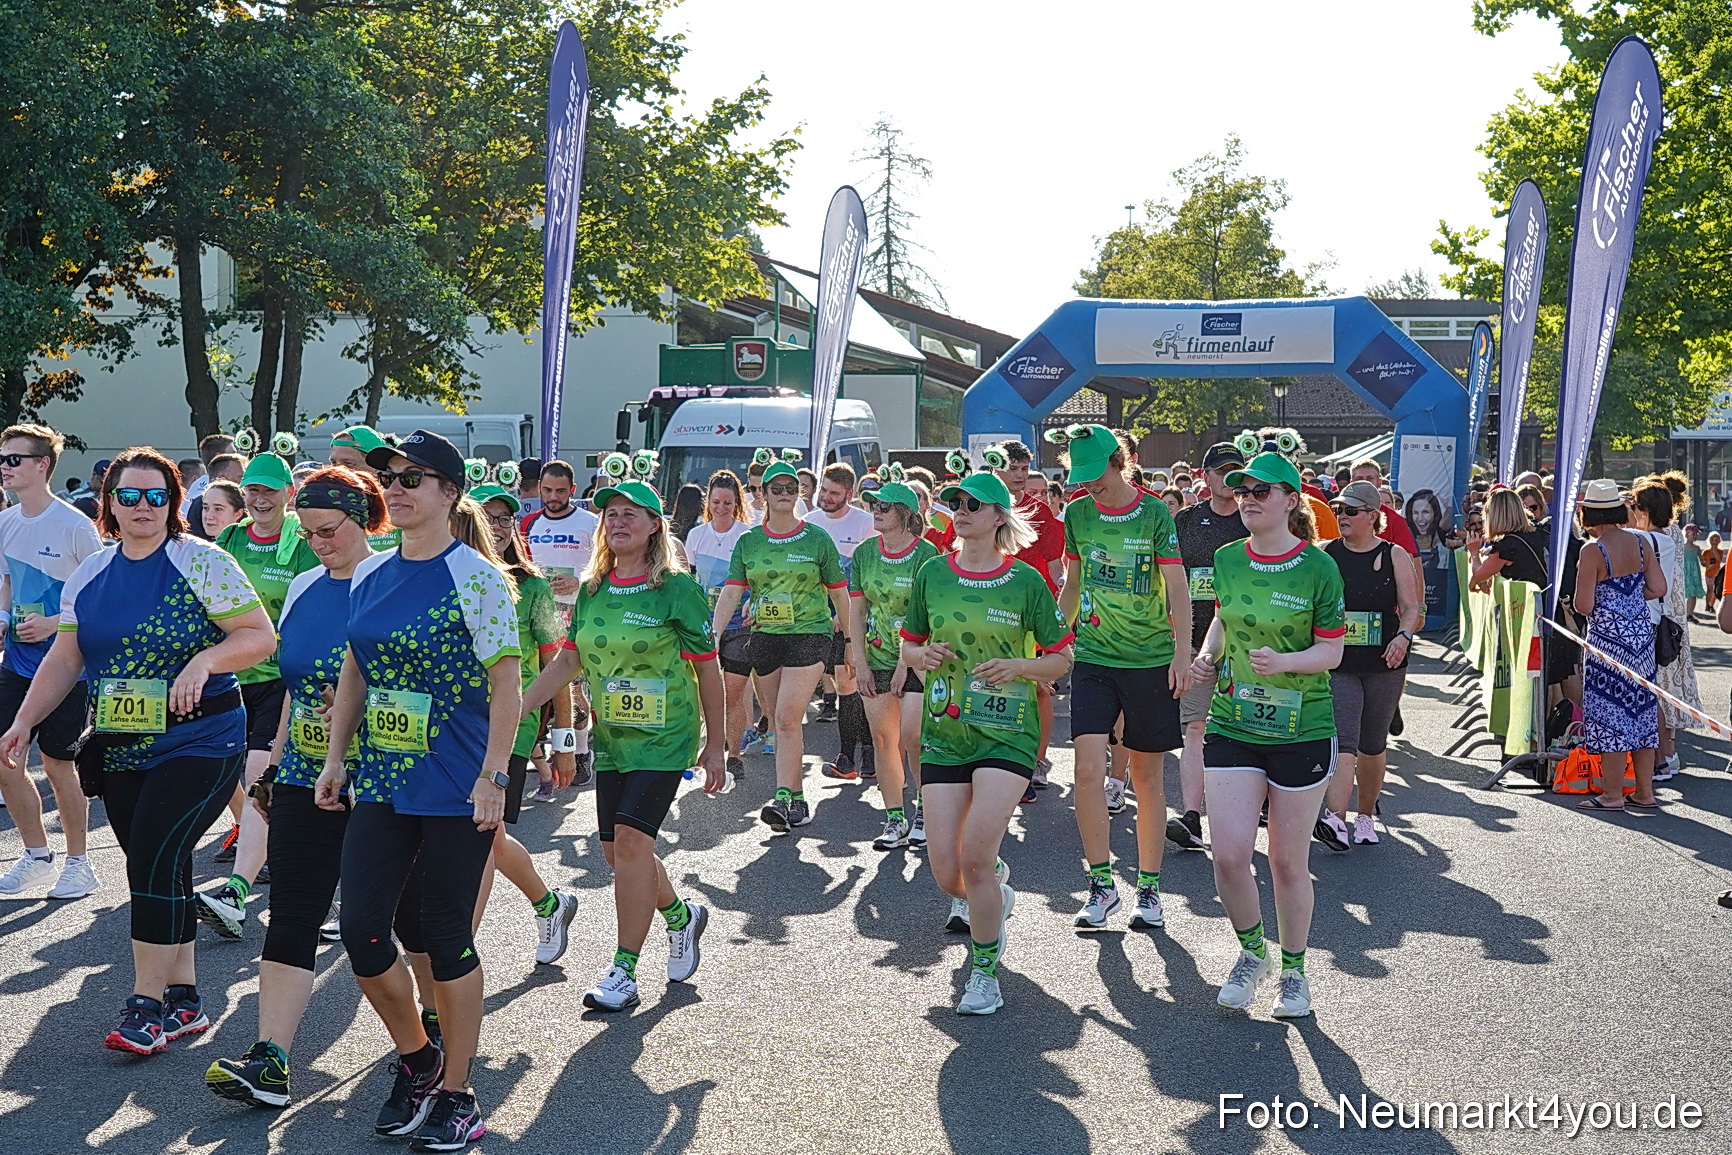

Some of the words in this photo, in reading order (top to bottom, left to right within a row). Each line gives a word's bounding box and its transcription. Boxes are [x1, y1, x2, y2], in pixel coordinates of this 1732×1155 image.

[560, 61, 577, 199] Fischer
[567, 82, 580, 194] AUTOMOBILE
[1604, 81, 1643, 222] Fischer
[1620, 105, 1649, 218] AUTOMOBILE
[832, 213, 855, 308] Fischer
[1515, 207, 1536, 305] Fischer
[1525, 221, 1540, 300] AUTOMOBILE
[842, 228, 859, 303] AUTOMOBILE
[1187, 335, 1275, 352] firmenlauf
[1017, 364, 1064, 375] Fischer
[673, 425, 714, 434] abavent
[747, 428, 804, 436] DATASPORT
[529, 528, 580, 544] RÖDL
[1098, 564, 1116, 578] 45
[1105, 578, 1125, 586] Sabrina
[1271, 591, 1309, 605] TRENDHAUS
[624, 611, 660, 624] TRENDHAUS
[765, 606, 779, 616] 56
[987, 607, 1021, 620] TRENDHAUS
[113, 697, 145, 715] 701
[621, 694, 644, 711] 98
[964, 696, 972, 714] RUN
[984, 695, 1007, 713] 48
[970, 710, 994, 719] Stöcker
[995, 713, 1017, 721] Sandra
[1017, 702, 1026, 725] 2022
[1253, 702, 1277, 721] 32
[376, 710, 409, 733] 699
[1268, 722, 1286, 730] Sarah
[1288, 710, 1297, 733] 2022
[393, 732, 417, 744] Claudia
